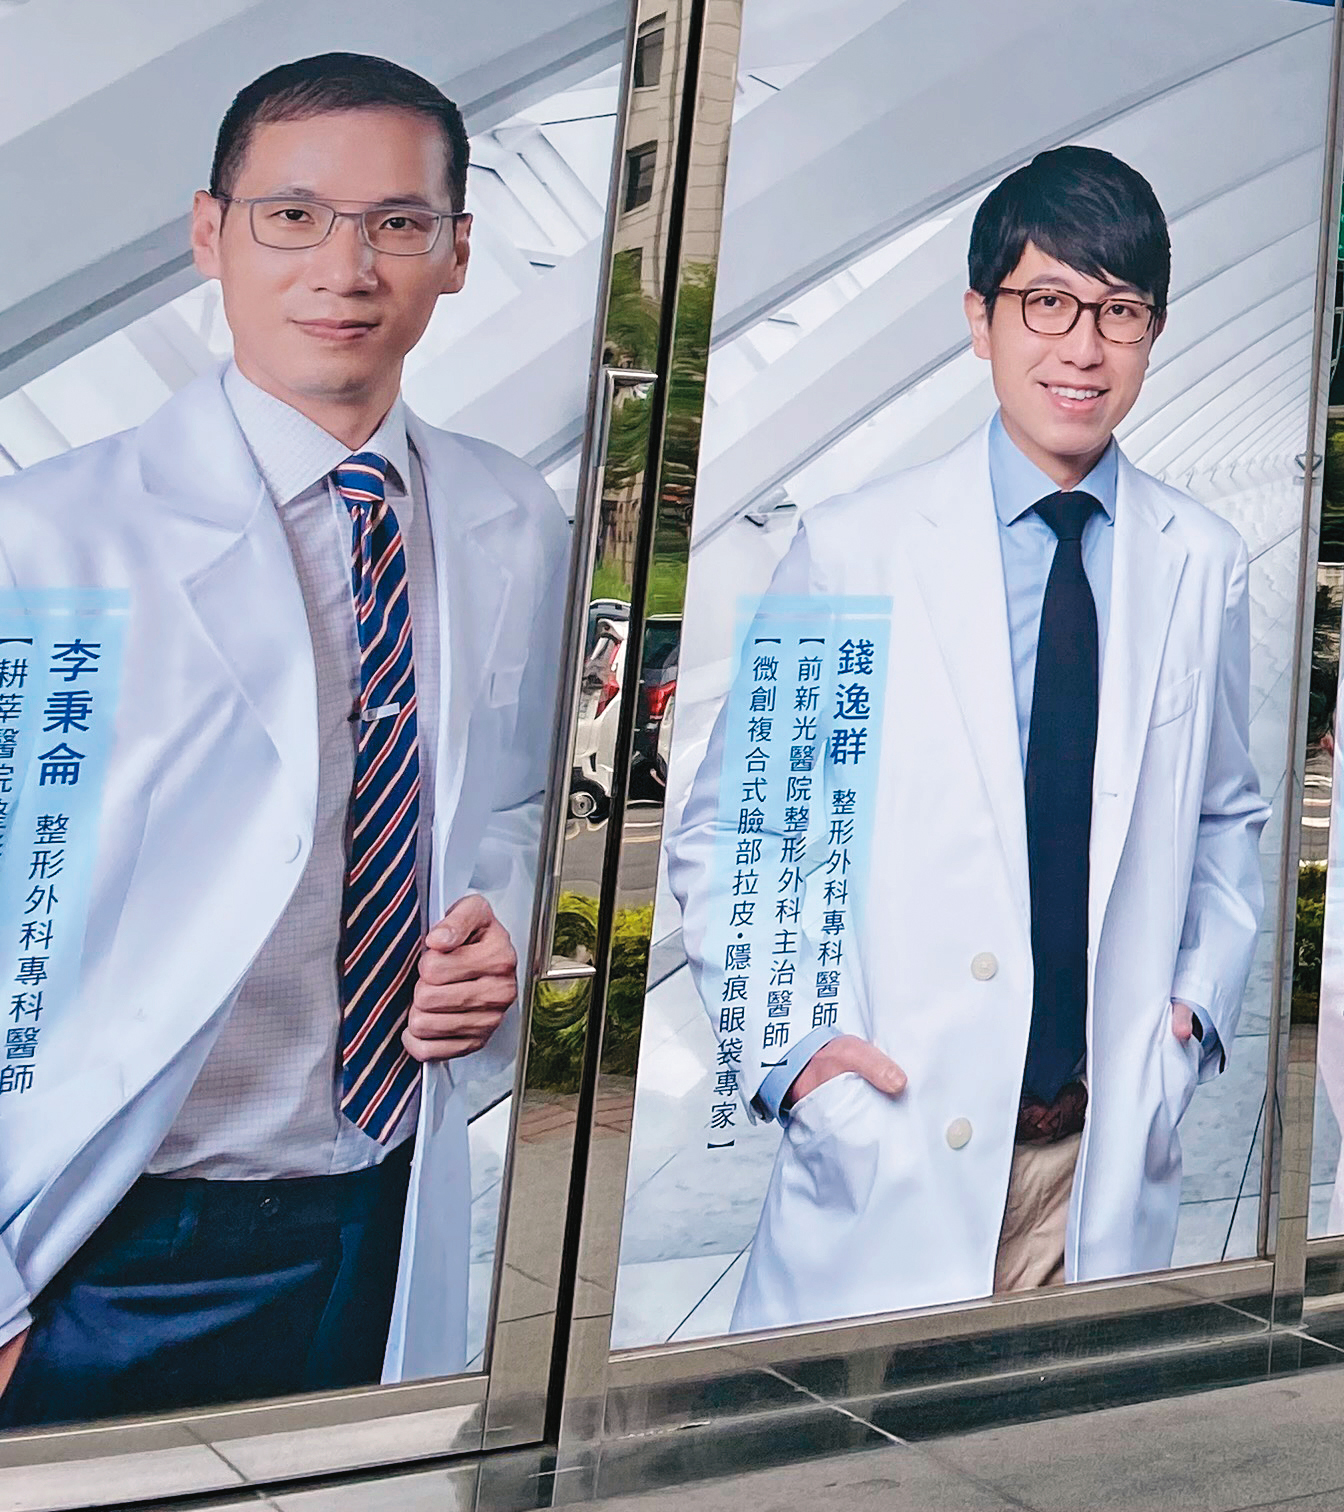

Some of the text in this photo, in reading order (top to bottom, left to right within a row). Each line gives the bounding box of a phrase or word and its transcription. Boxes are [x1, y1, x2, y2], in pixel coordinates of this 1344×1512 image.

[37, 638, 101, 786] 李秉侖
[811, 638, 876, 1028] 錢逸群 整形外科專科醫師
